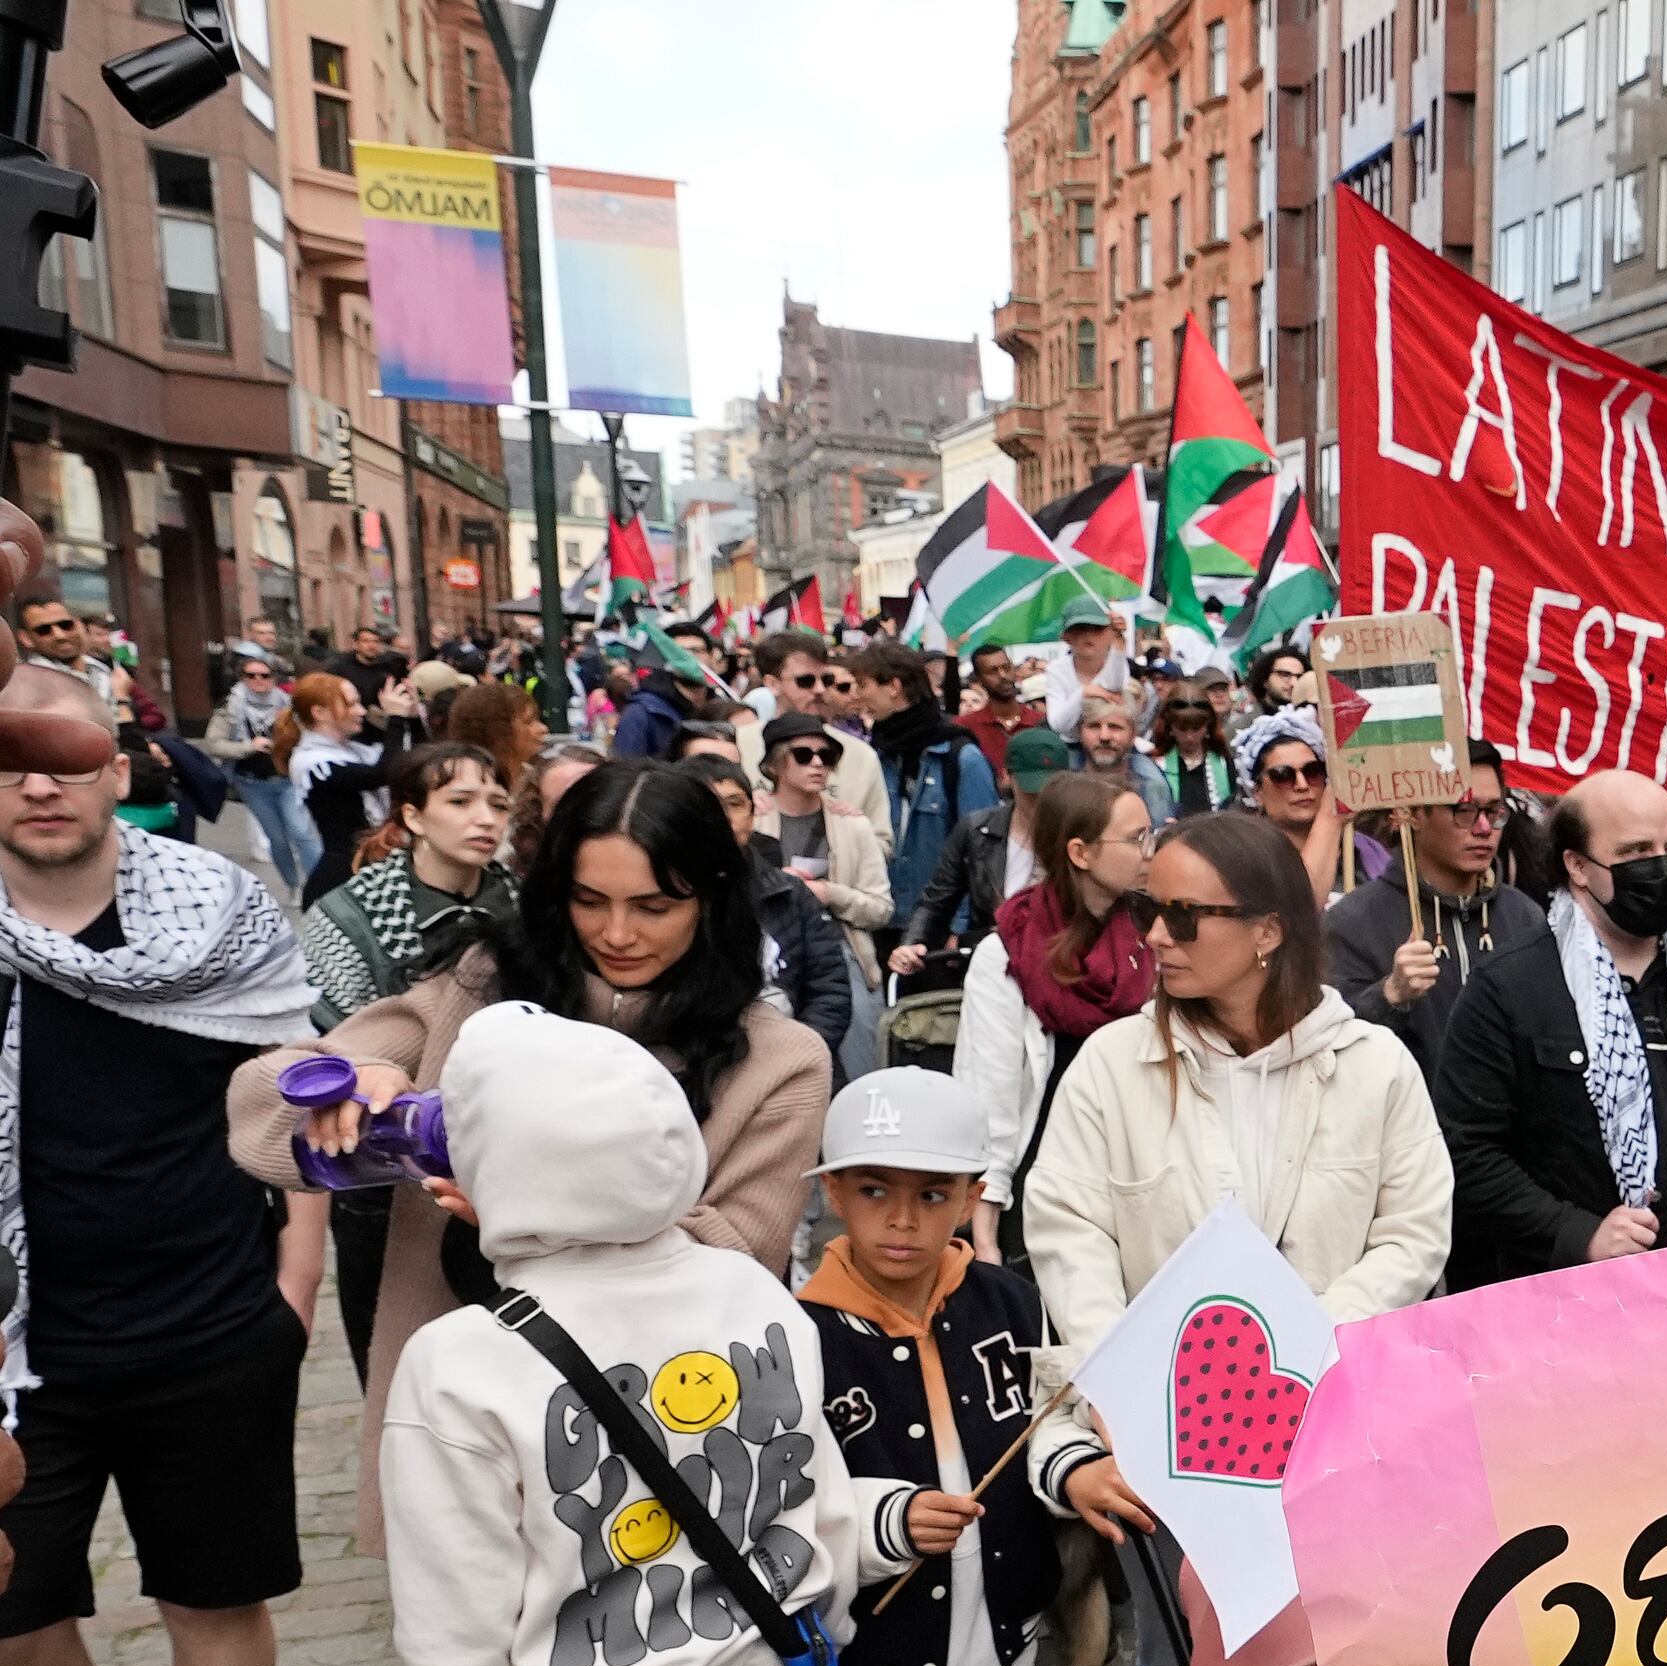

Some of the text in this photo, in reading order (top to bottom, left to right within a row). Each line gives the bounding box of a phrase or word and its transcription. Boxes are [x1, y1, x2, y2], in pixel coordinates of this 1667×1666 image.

[1342, 626, 1424, 655] BEFRIA
[1348, 769, 1465, 804] PALESTINA
[862, 1087, 902, 1137] LA
